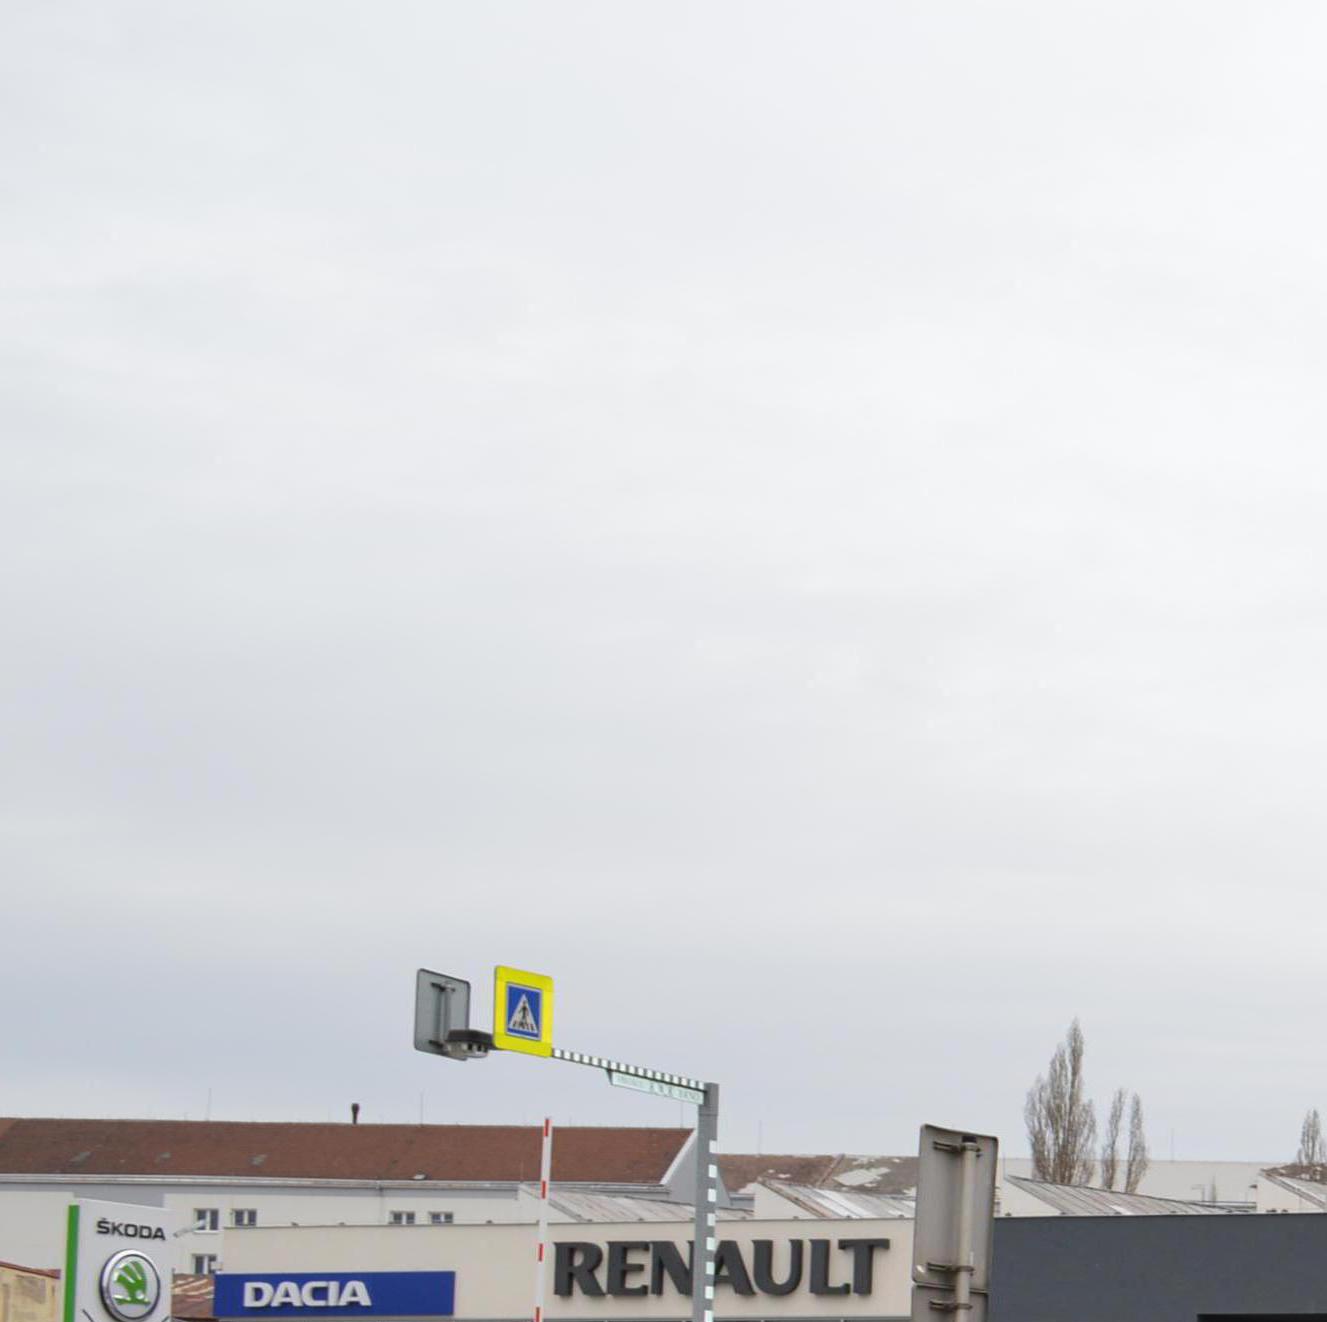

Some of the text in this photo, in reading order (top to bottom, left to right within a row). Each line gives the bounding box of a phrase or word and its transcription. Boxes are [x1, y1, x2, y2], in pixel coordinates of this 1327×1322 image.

[96, 1217, 166, 1240] ŠKODA
[553, 1238, 891, 1297] RENAULT
[243, 1280, 372, 1307] DACIA
